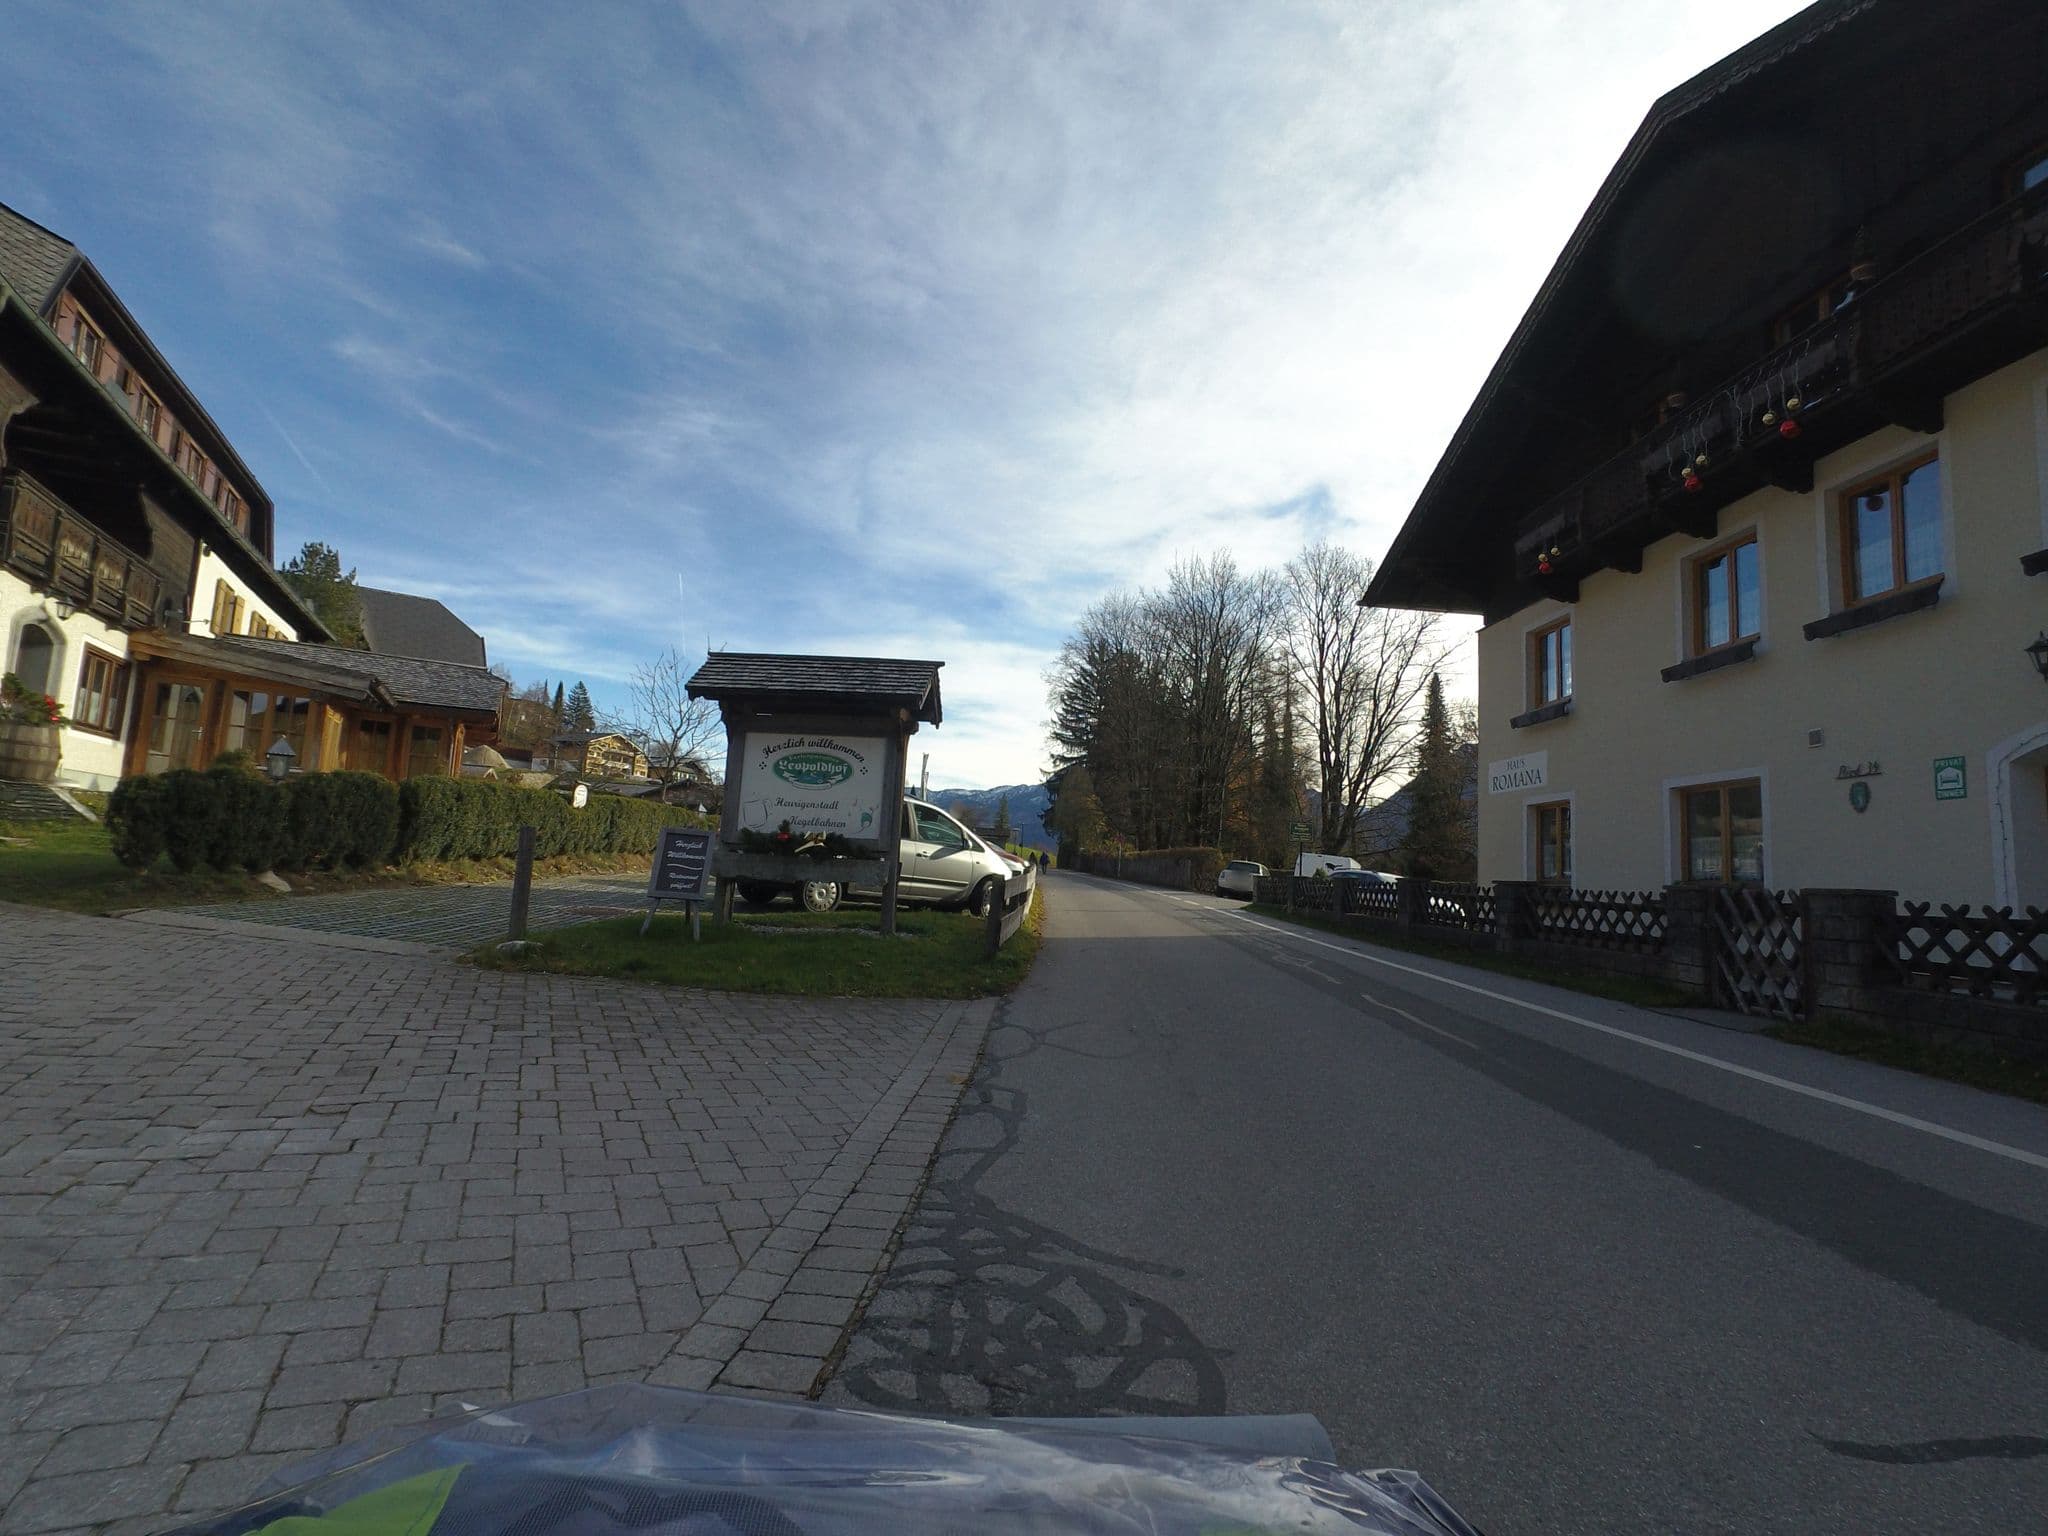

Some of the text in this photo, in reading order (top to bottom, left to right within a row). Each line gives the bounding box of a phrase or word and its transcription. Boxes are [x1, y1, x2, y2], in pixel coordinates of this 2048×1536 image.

[762, 737, 805, 760] Herzlich
[807, 738, 866, 763] willkommen
[778, 760, 848, 774] Leopoldhof
[1935, 757, 1963, 767] PRIVAT
[1492, 769, 1542, 791] ROMANA
